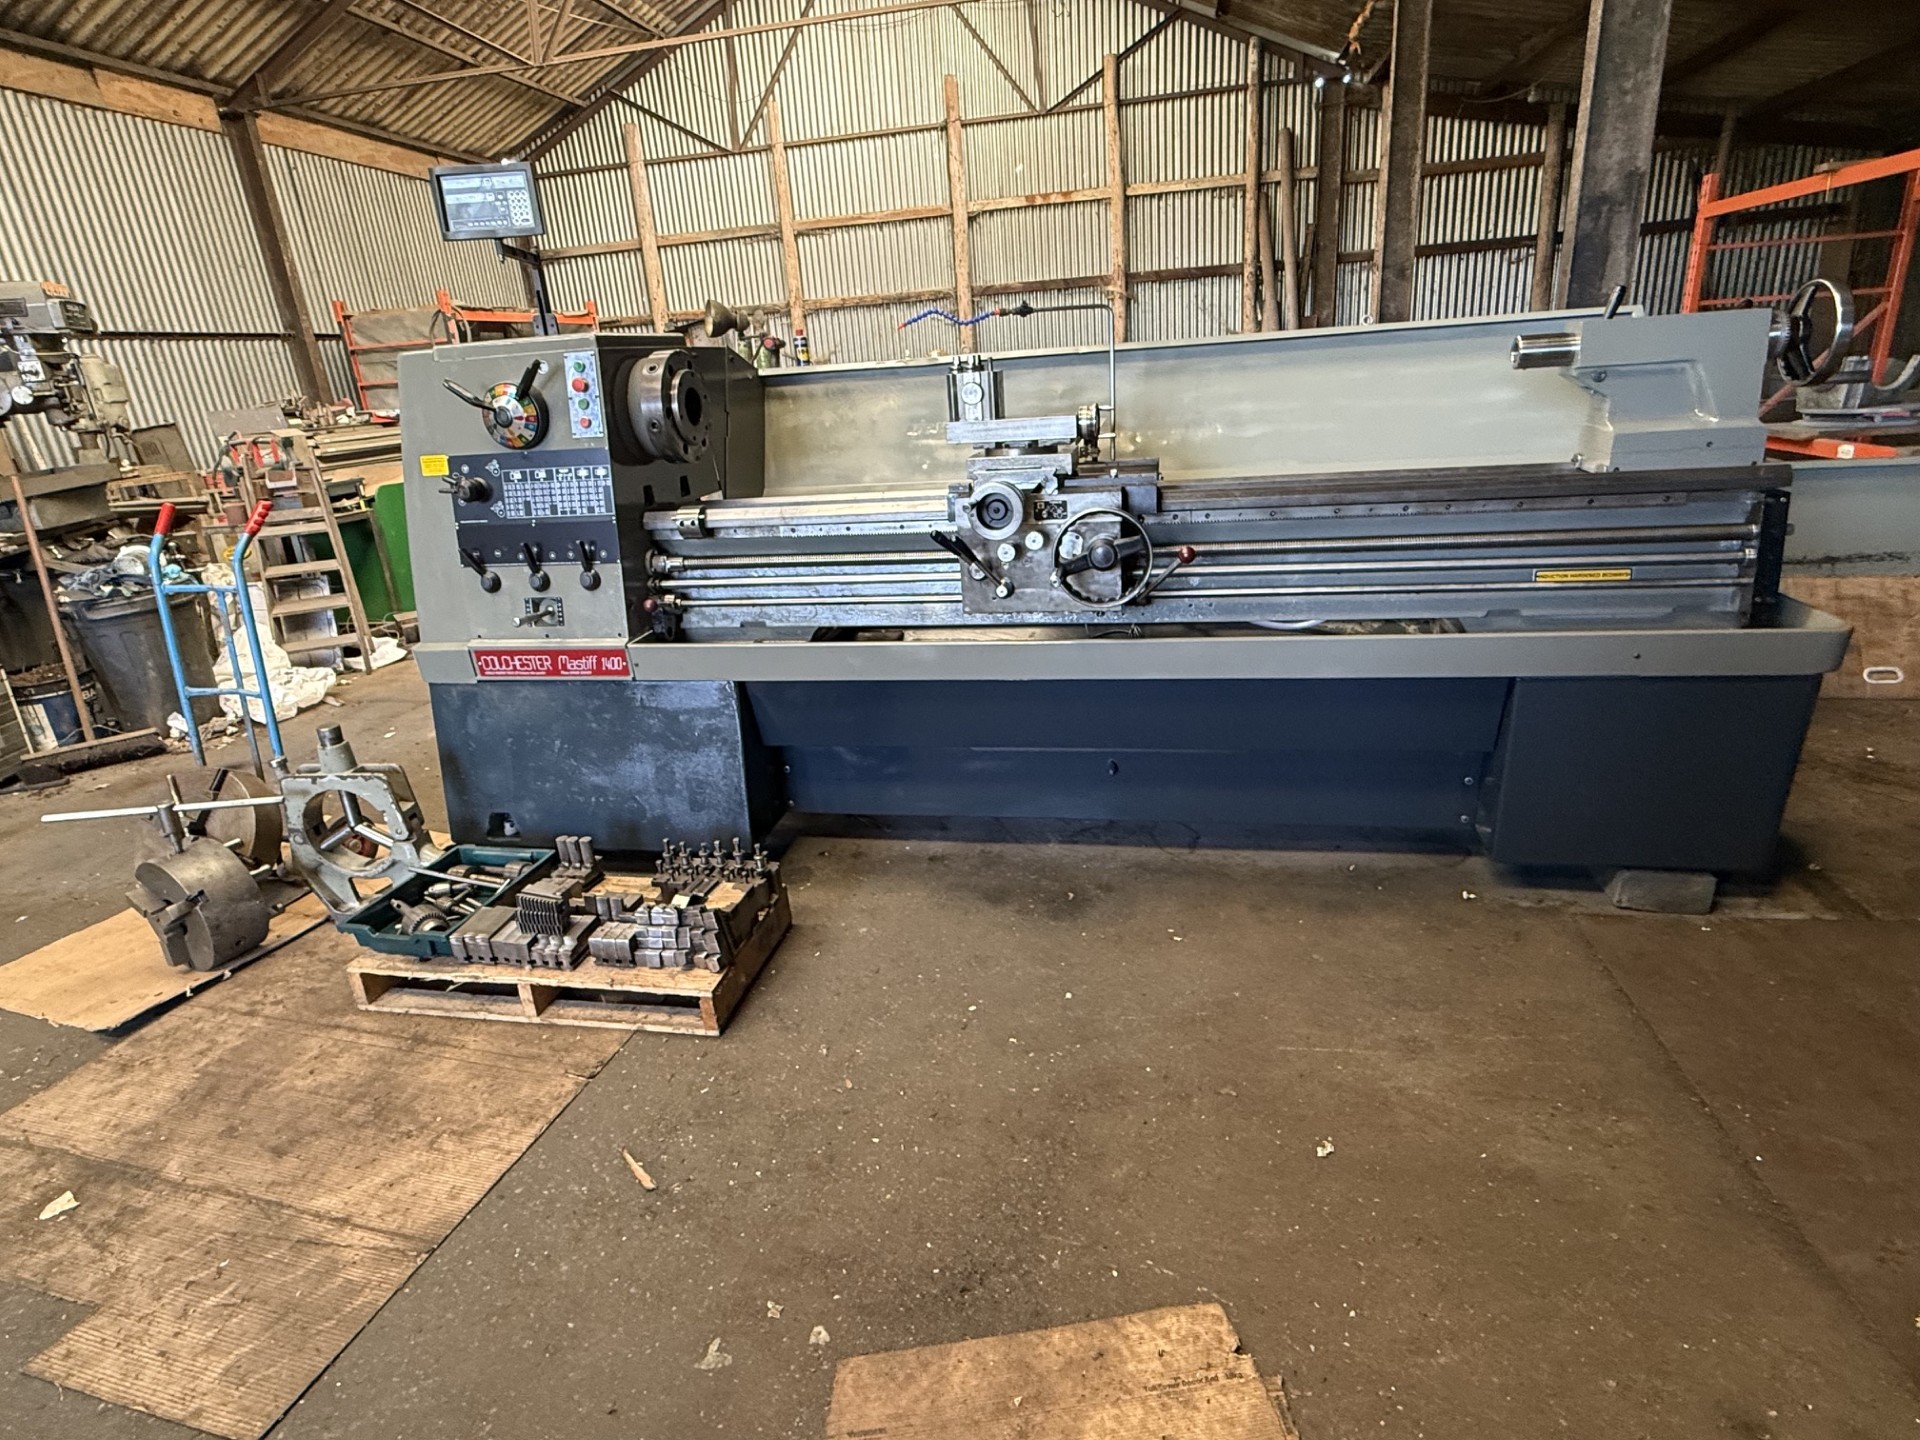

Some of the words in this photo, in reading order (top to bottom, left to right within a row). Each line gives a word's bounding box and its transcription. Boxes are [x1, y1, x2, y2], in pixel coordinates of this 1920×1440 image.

[481, 655, 552, 670] COLCHESTER
[558, 655, 597, 670] Mastiff
[601, 656, 622, 670] 1400
